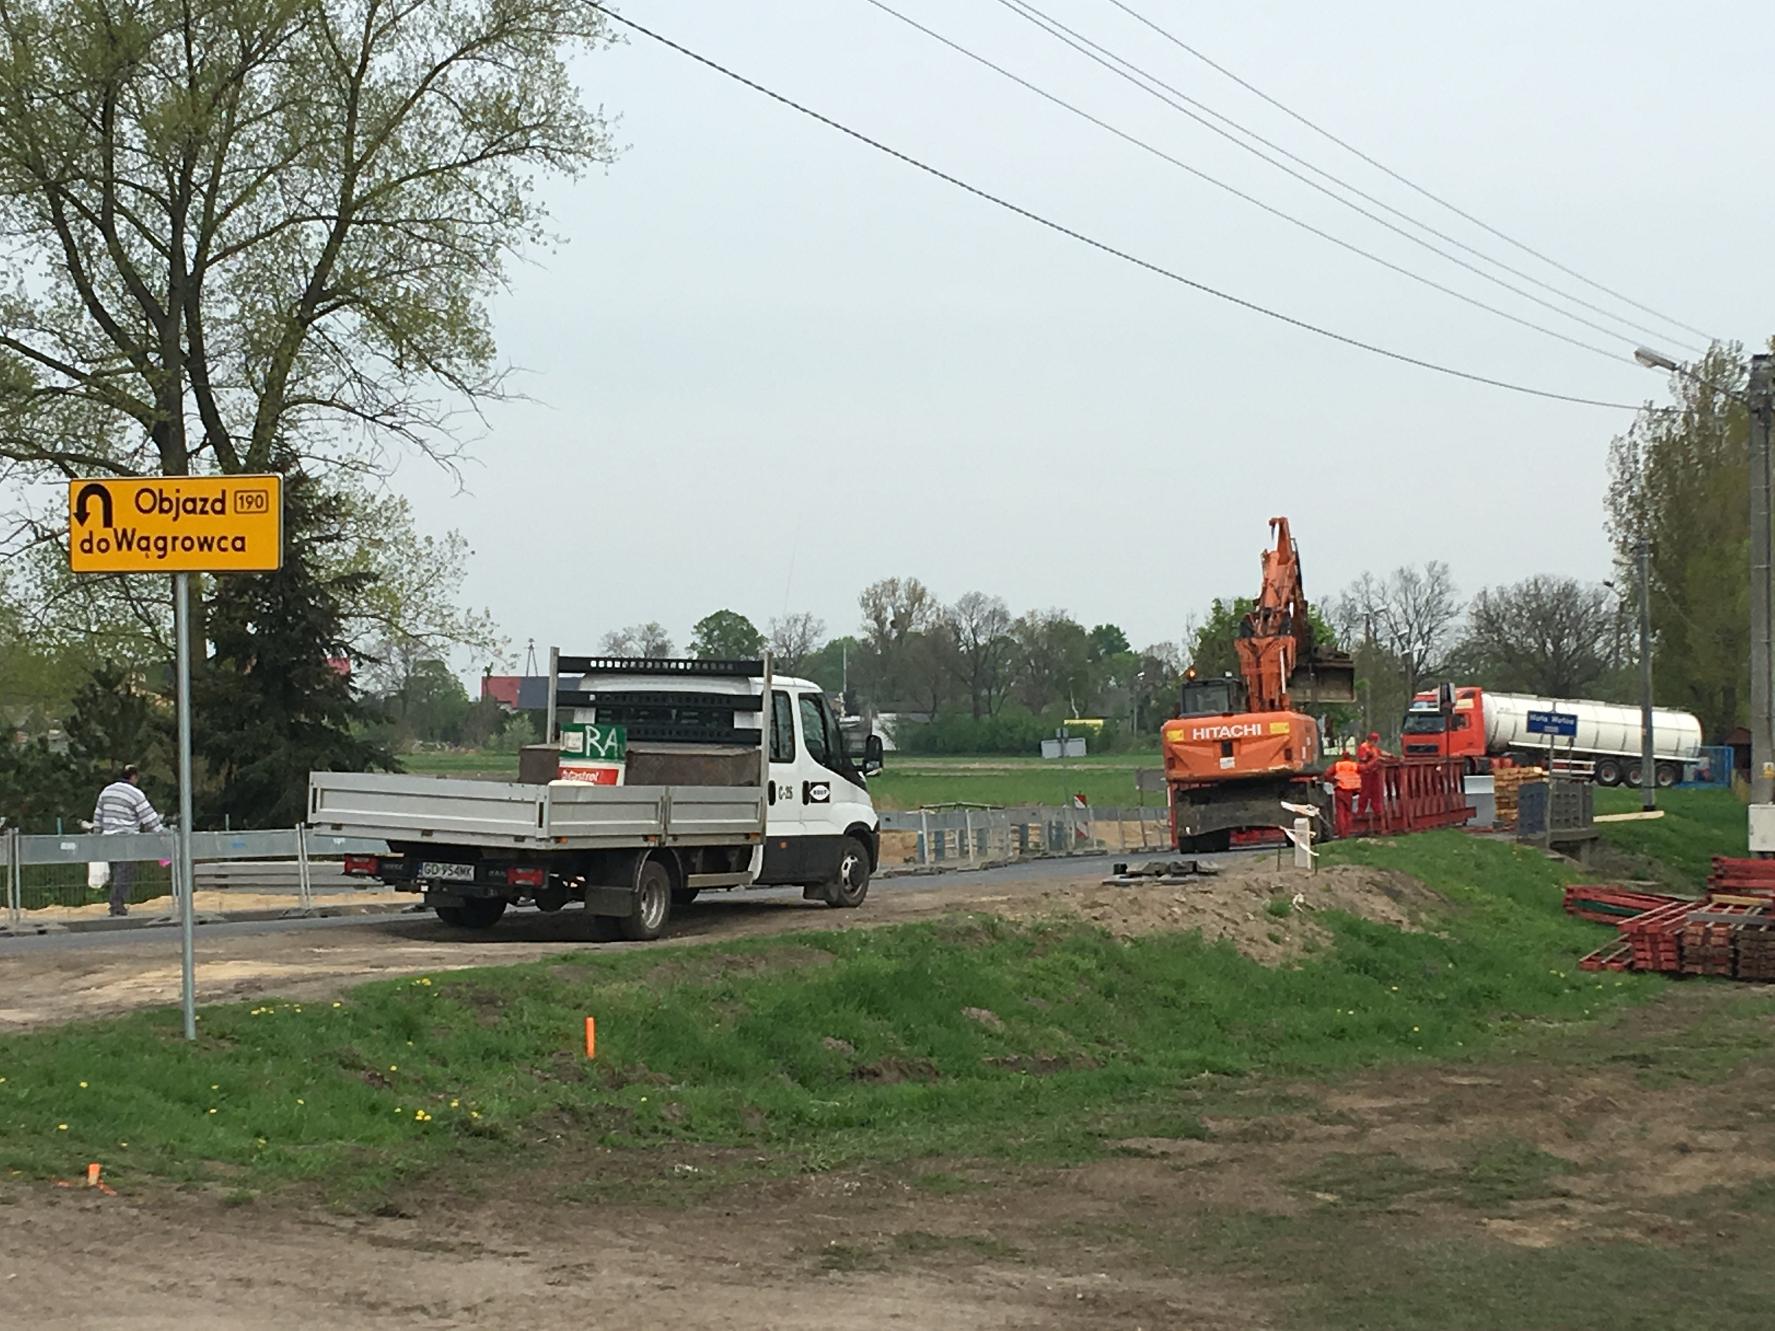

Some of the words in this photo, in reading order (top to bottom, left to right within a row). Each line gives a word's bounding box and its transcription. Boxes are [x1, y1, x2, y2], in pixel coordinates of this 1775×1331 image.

[134, 487, 226, 522] Objazd
[238, 494, 265, 510] 190
[79, 530, 111, 555] do
[113, 527, 246, 560] Wągrowca
[1192, 723, 1262, 741] HITACHI
